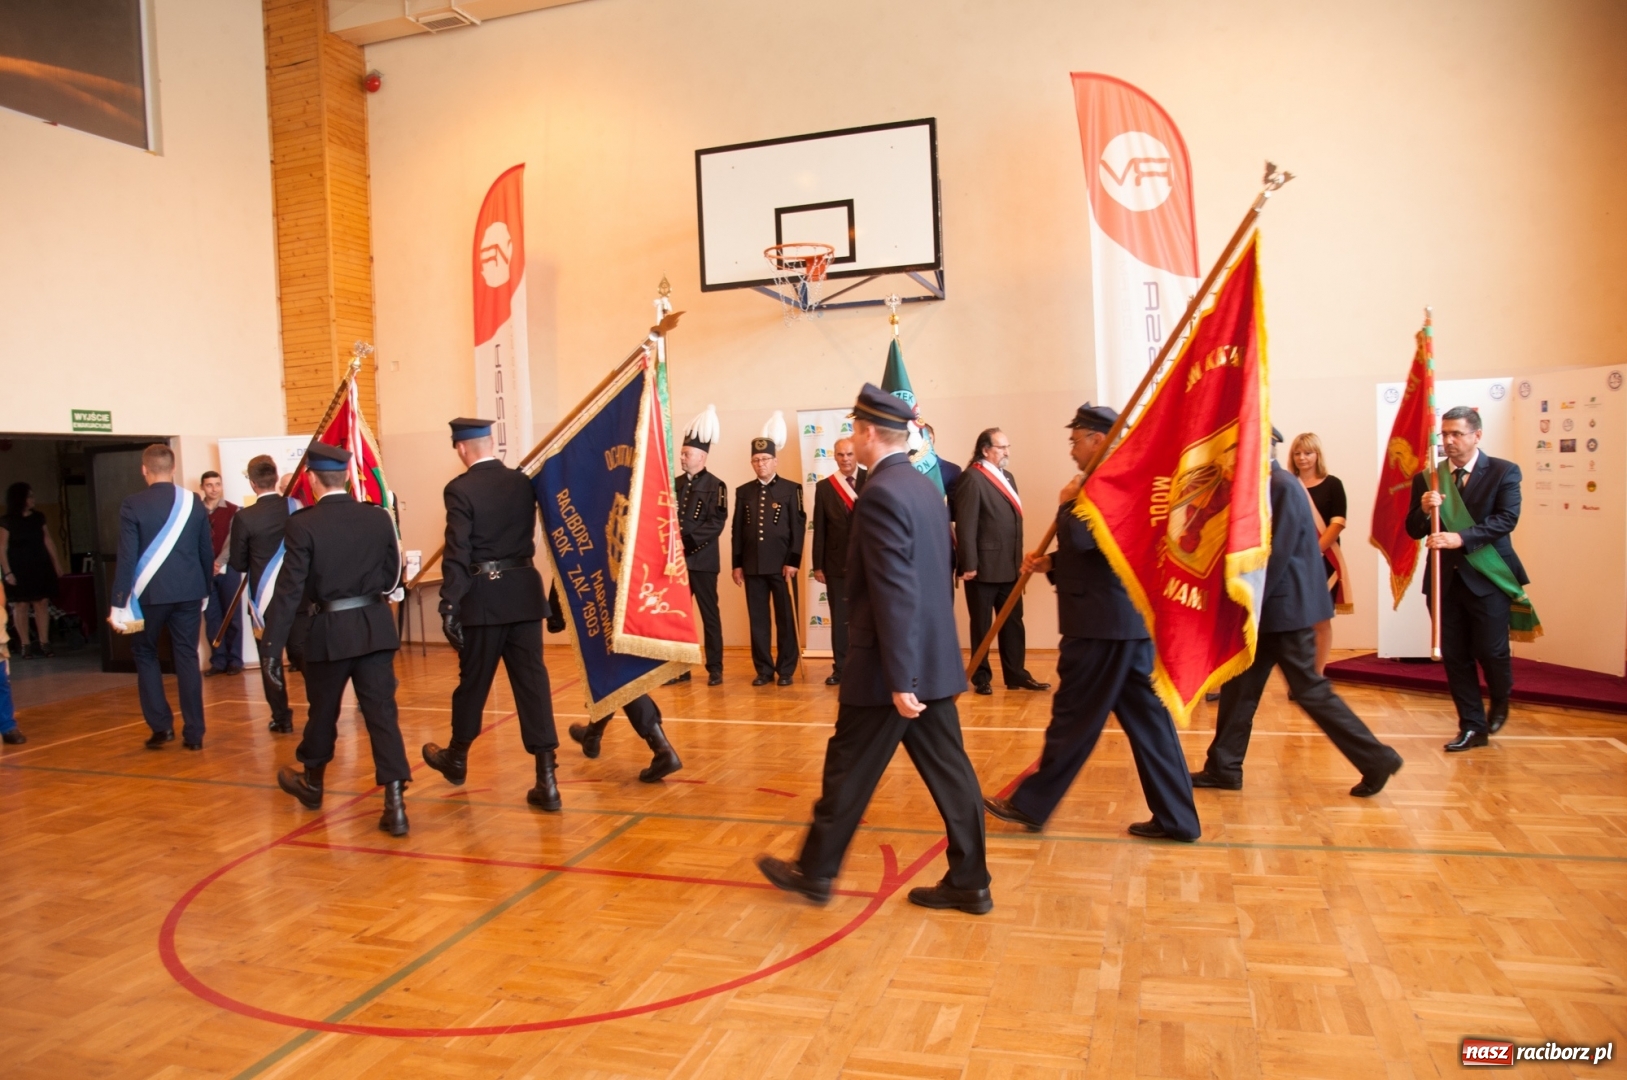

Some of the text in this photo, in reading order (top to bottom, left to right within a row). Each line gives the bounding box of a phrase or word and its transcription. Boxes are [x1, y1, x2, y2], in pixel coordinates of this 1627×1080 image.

[74, 412, 110, 422] WYJŚCIE
[551, 526, 574, 558] ROK
[582, 600, 600, 637] 1903
